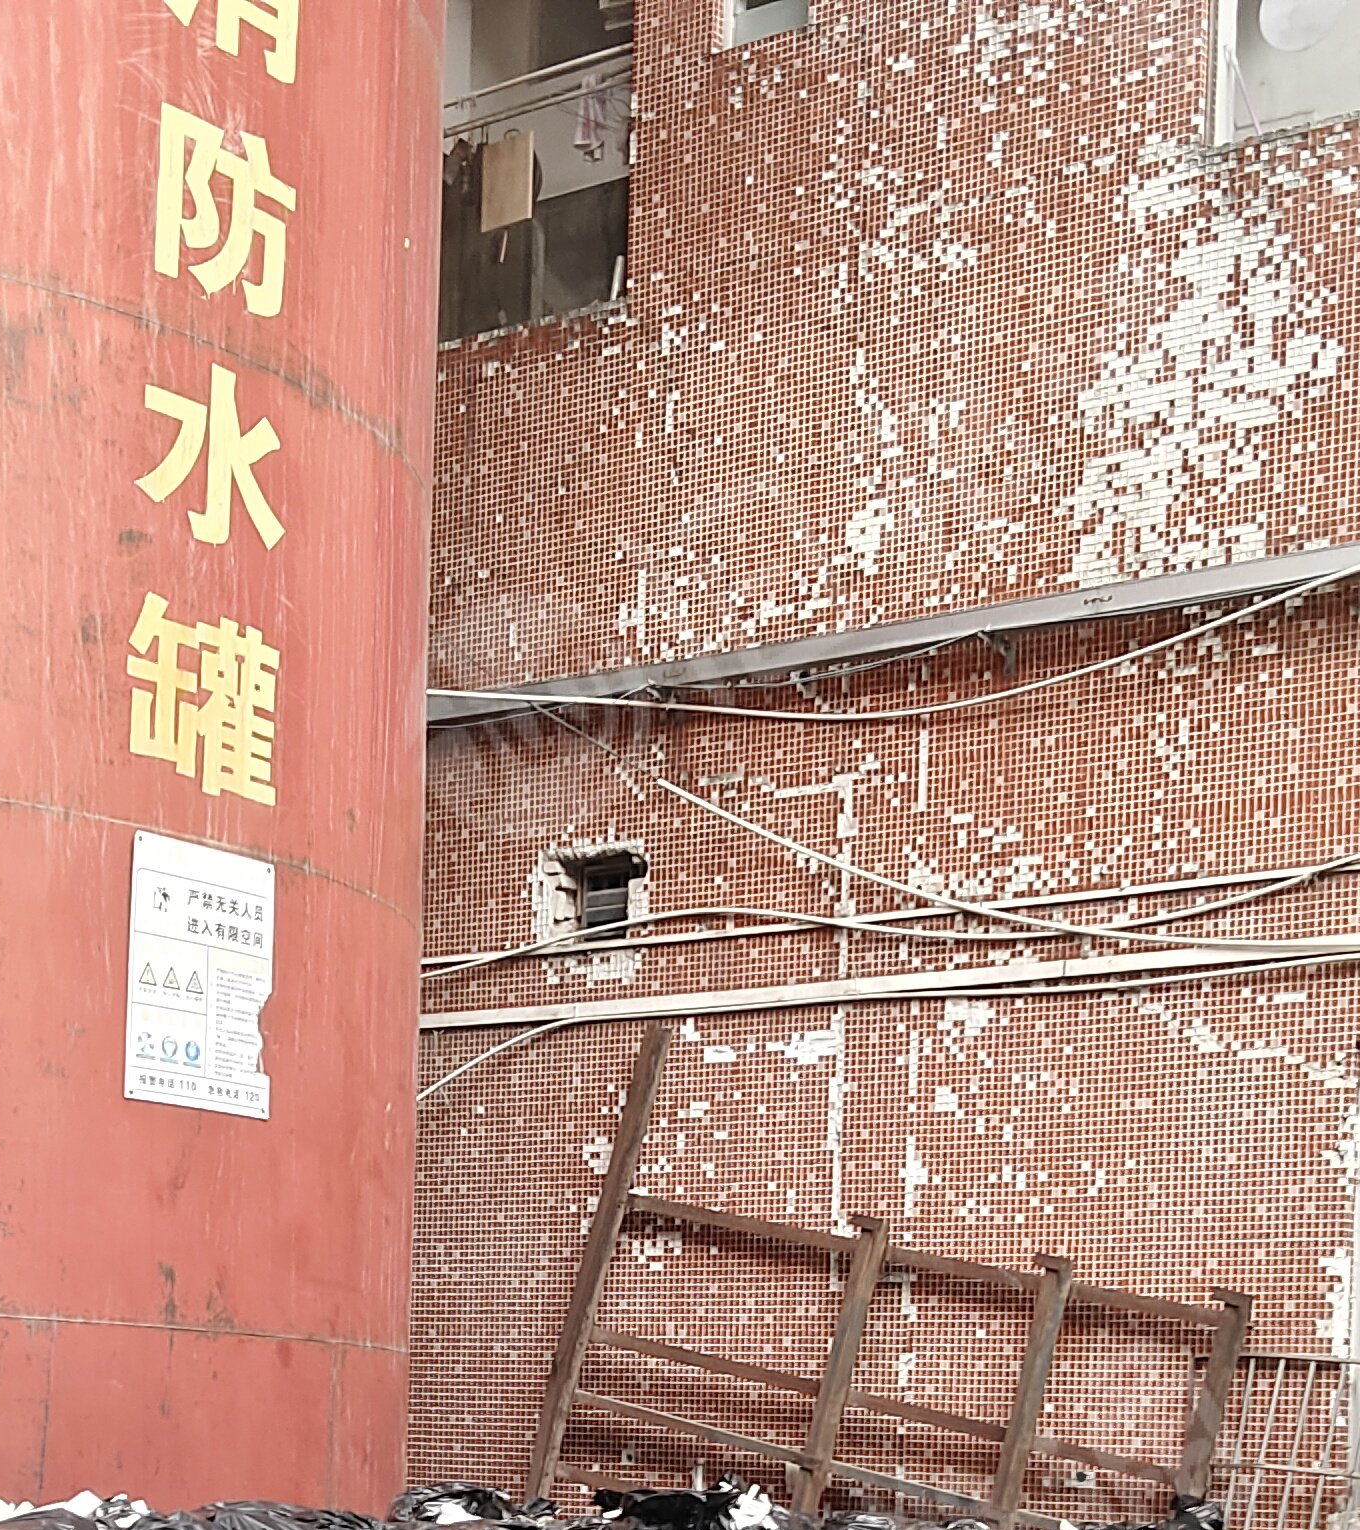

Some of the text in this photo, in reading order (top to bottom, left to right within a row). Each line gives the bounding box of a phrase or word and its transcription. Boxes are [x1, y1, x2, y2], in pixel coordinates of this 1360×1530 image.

[187, 889, 264, 922] 严禁无关人员
[186, 916, 264, 949] 进入有限空间
